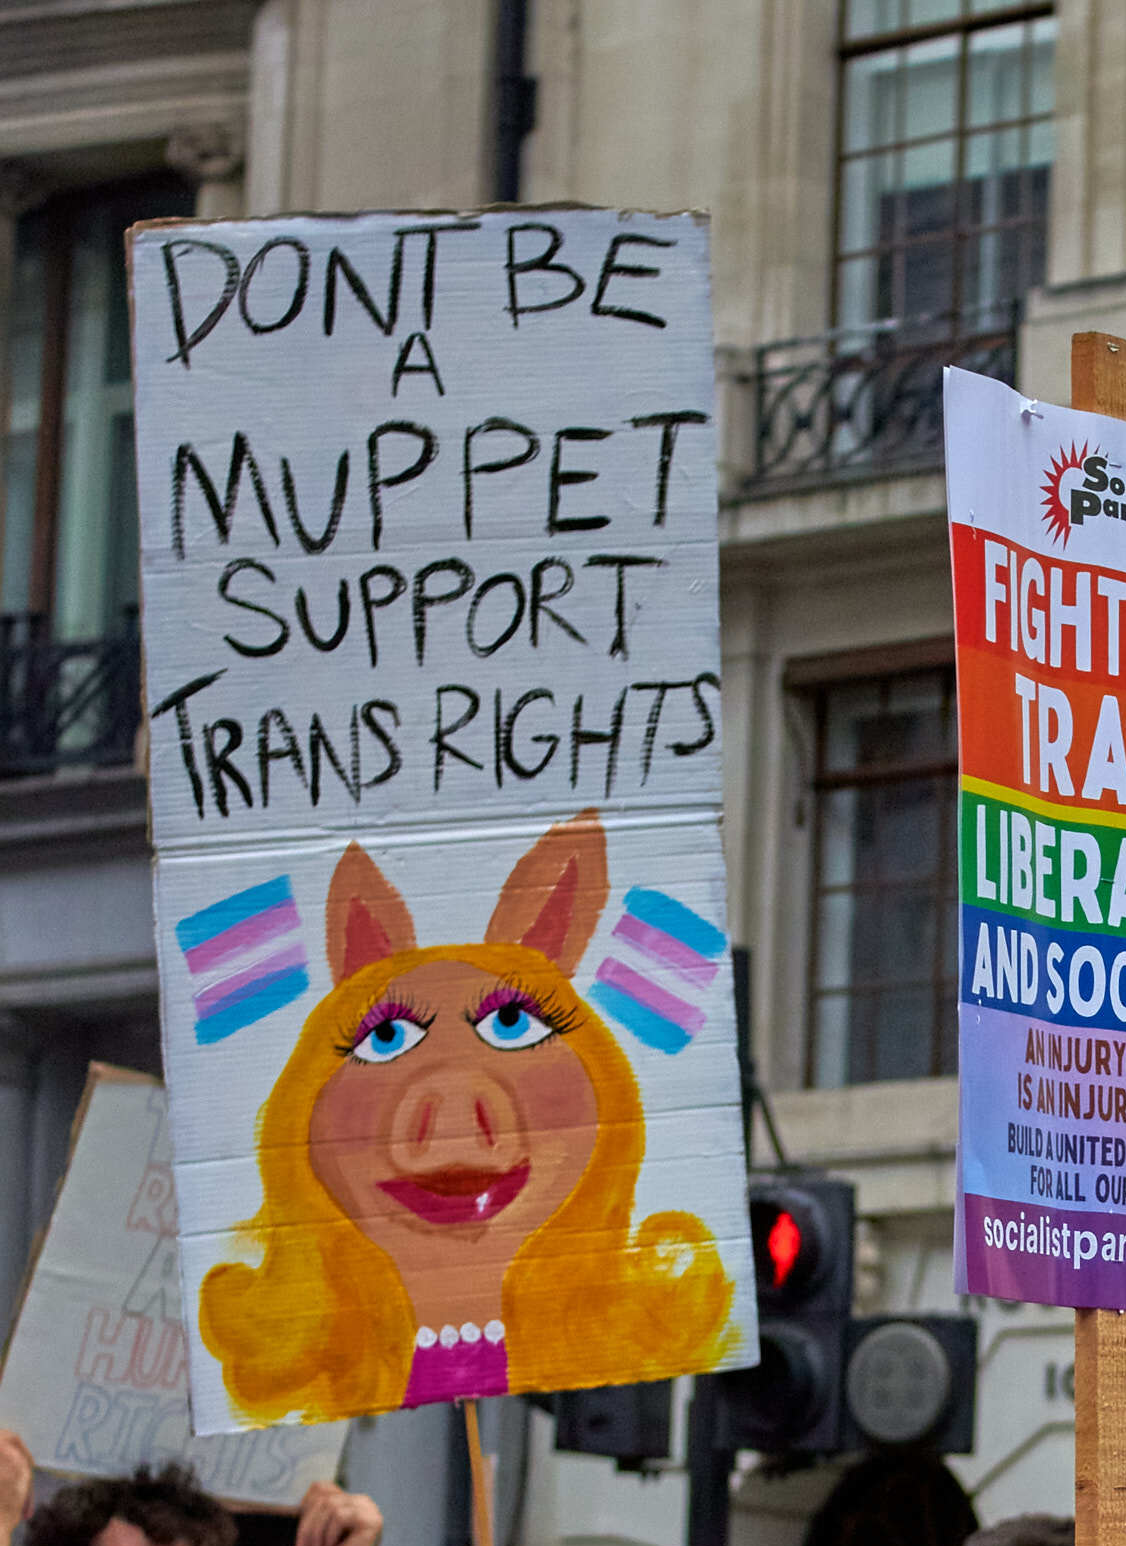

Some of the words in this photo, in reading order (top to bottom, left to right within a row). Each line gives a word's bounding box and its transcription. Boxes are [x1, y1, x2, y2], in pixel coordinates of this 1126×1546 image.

[162, 223, 481, 369] DONT
[503, 224, 679, 329] BE
[392, 332, 446, 398] A
[170, 411, 711, 561] MUPPET
[218, 555, 668, 668] SUPPORT
[151, 668, 400, 820] TRANS
[429, 672, 722, 800] RIGHTS
[972, 922, 1039, 1006] AND
[1025, 1027, 1045, 1068] AN
[1048, 1033, 1126, 1077] INJURY
[1018, 1072, 1033, 1111] IS
[1036, 1077, 1055, 1116] AN
[1007, 1123, 1043, 1158] BUILD
[1046, 1130, 1054, 1161] A
[1055, 1131, 1126, 1168] UNITED
[1030, 1165, 1053, 1198] FOR
[1056, 1171, 1086, 1202] ALL
